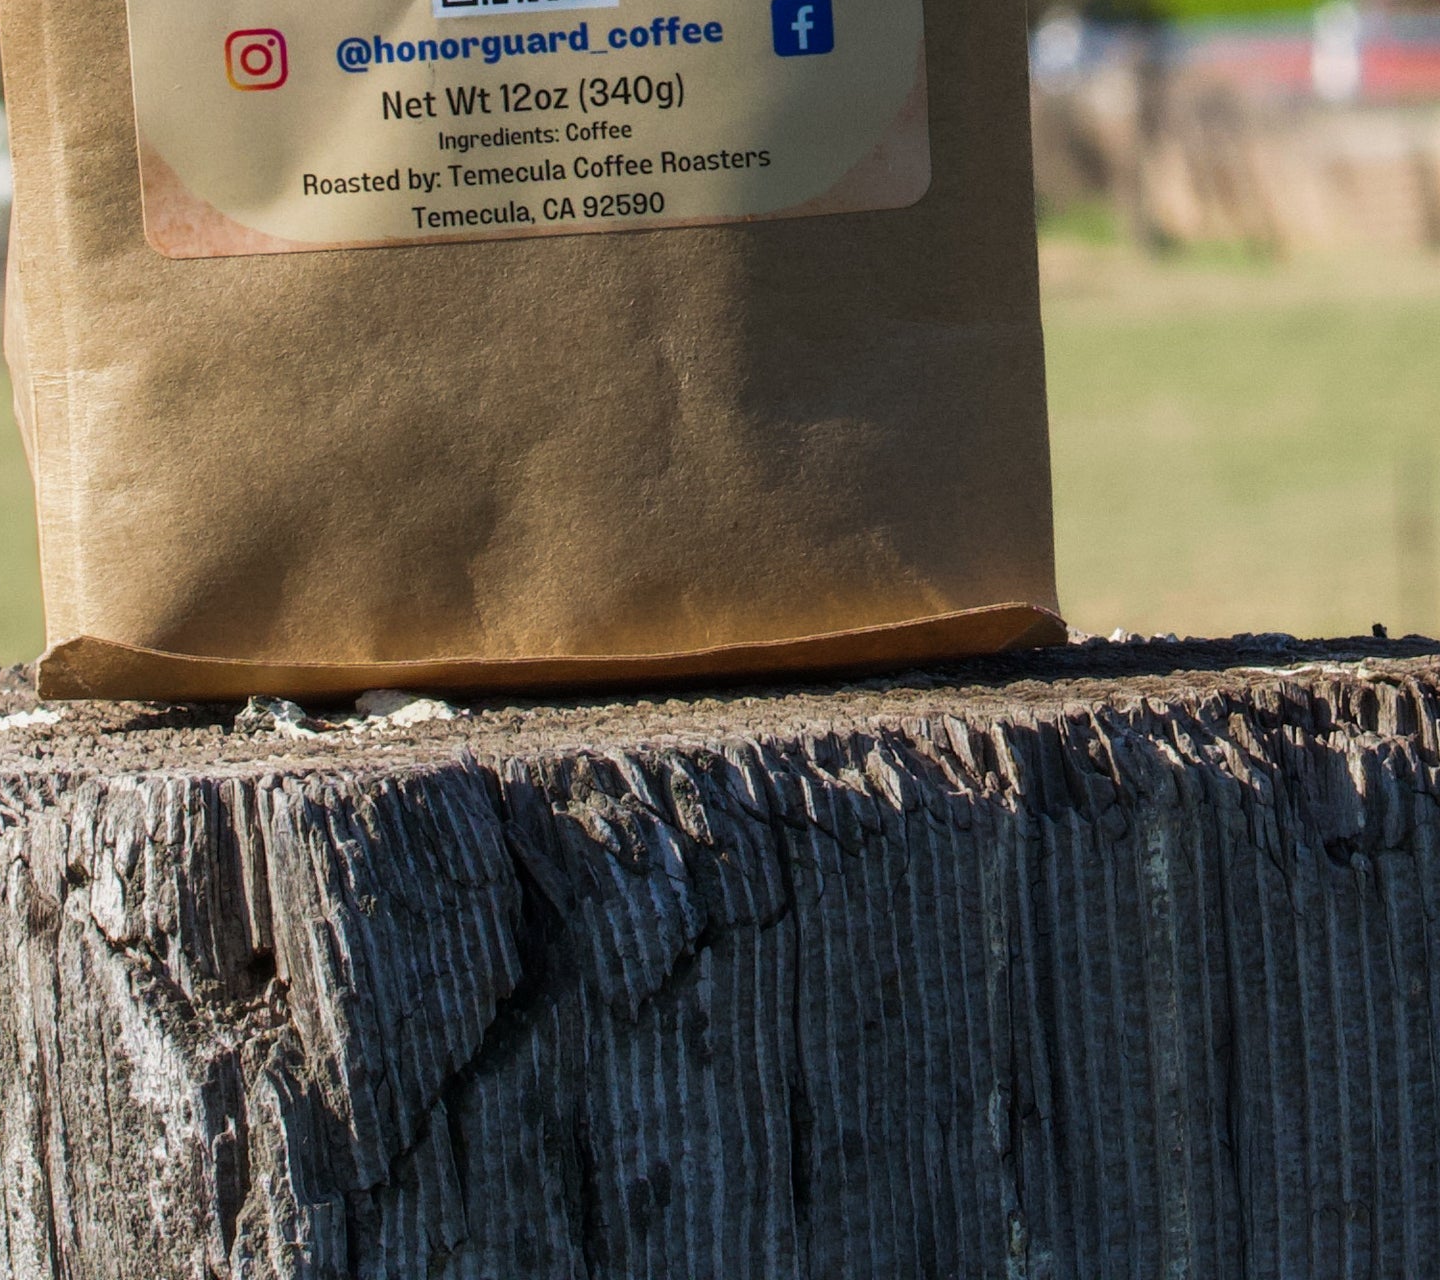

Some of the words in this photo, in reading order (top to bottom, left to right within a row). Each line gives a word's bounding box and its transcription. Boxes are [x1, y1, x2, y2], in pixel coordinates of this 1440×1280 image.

[336, 16, 723, 73] @honorguard_coffee
[382, 90, 438, 120] Net
[445, 85, 492, 116] Wt
[499, 82, 569, 113] 12oz
[579, 72, 684, 114] (340g)
[438, 126, 560, 154] Ingredients:
[565, 120, 632, 142] Coffee
[303, 168, 401, 196] Roasted
[408, 167, 442, 194] by:
[447, 158, 567, 187] Temecula
[573, 154, 653, 179] Coffee
[660, 149, 771, 174] Roasters
[411, 200, 536, 229] Temecula,
[542, 197, 576, 221] CA
[582, 191, 665, 218] 92590
